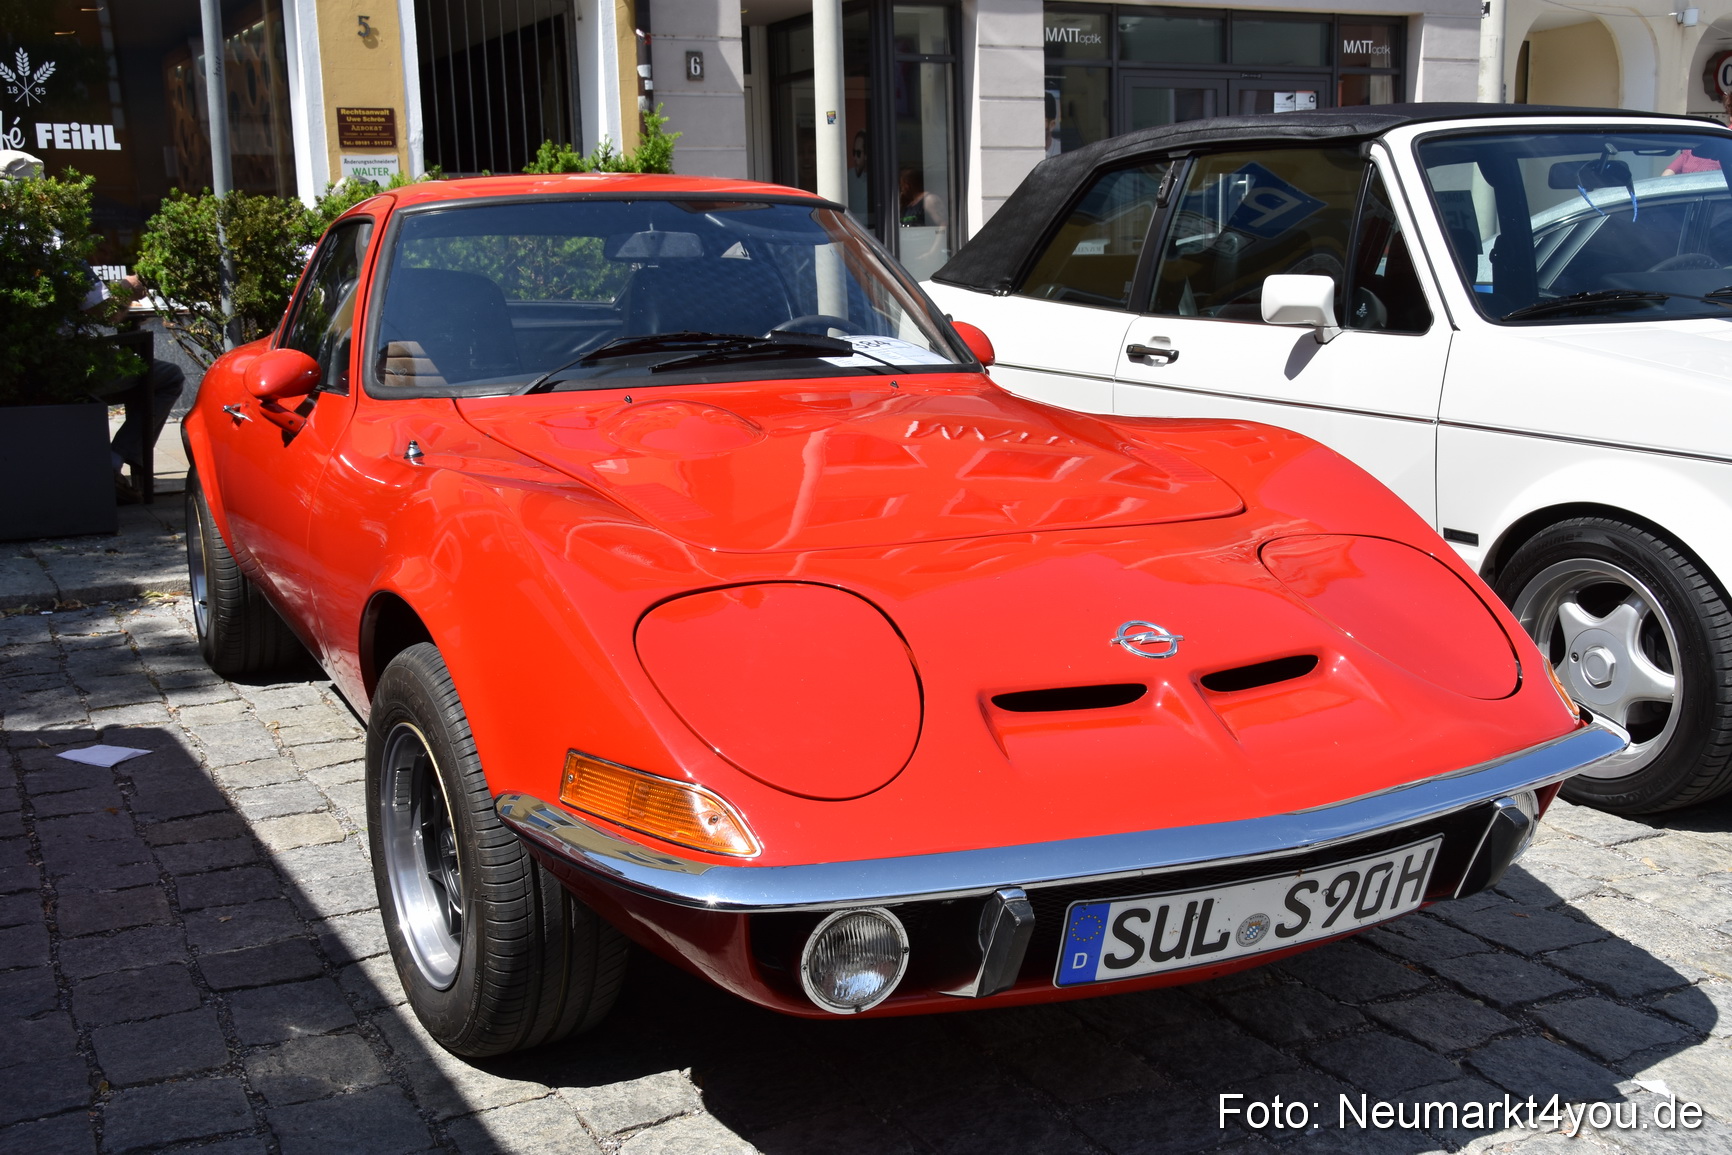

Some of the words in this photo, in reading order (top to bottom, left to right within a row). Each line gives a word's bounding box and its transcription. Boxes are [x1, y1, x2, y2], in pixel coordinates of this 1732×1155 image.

[358, 15, 370, 37] 5
[690, 56, 700, 75] 6
[7, 86, 19, 94] 18
[34, 87, 46, 95] 95
[340, 108, 390, 116] Rechtsanwalt
[352, 167, 390, 176] WALTER
[90, 264, 127, 280] EiHL
[1103, 898, 1231, 970] SUL
[1071, 952, 1089, 970] D
